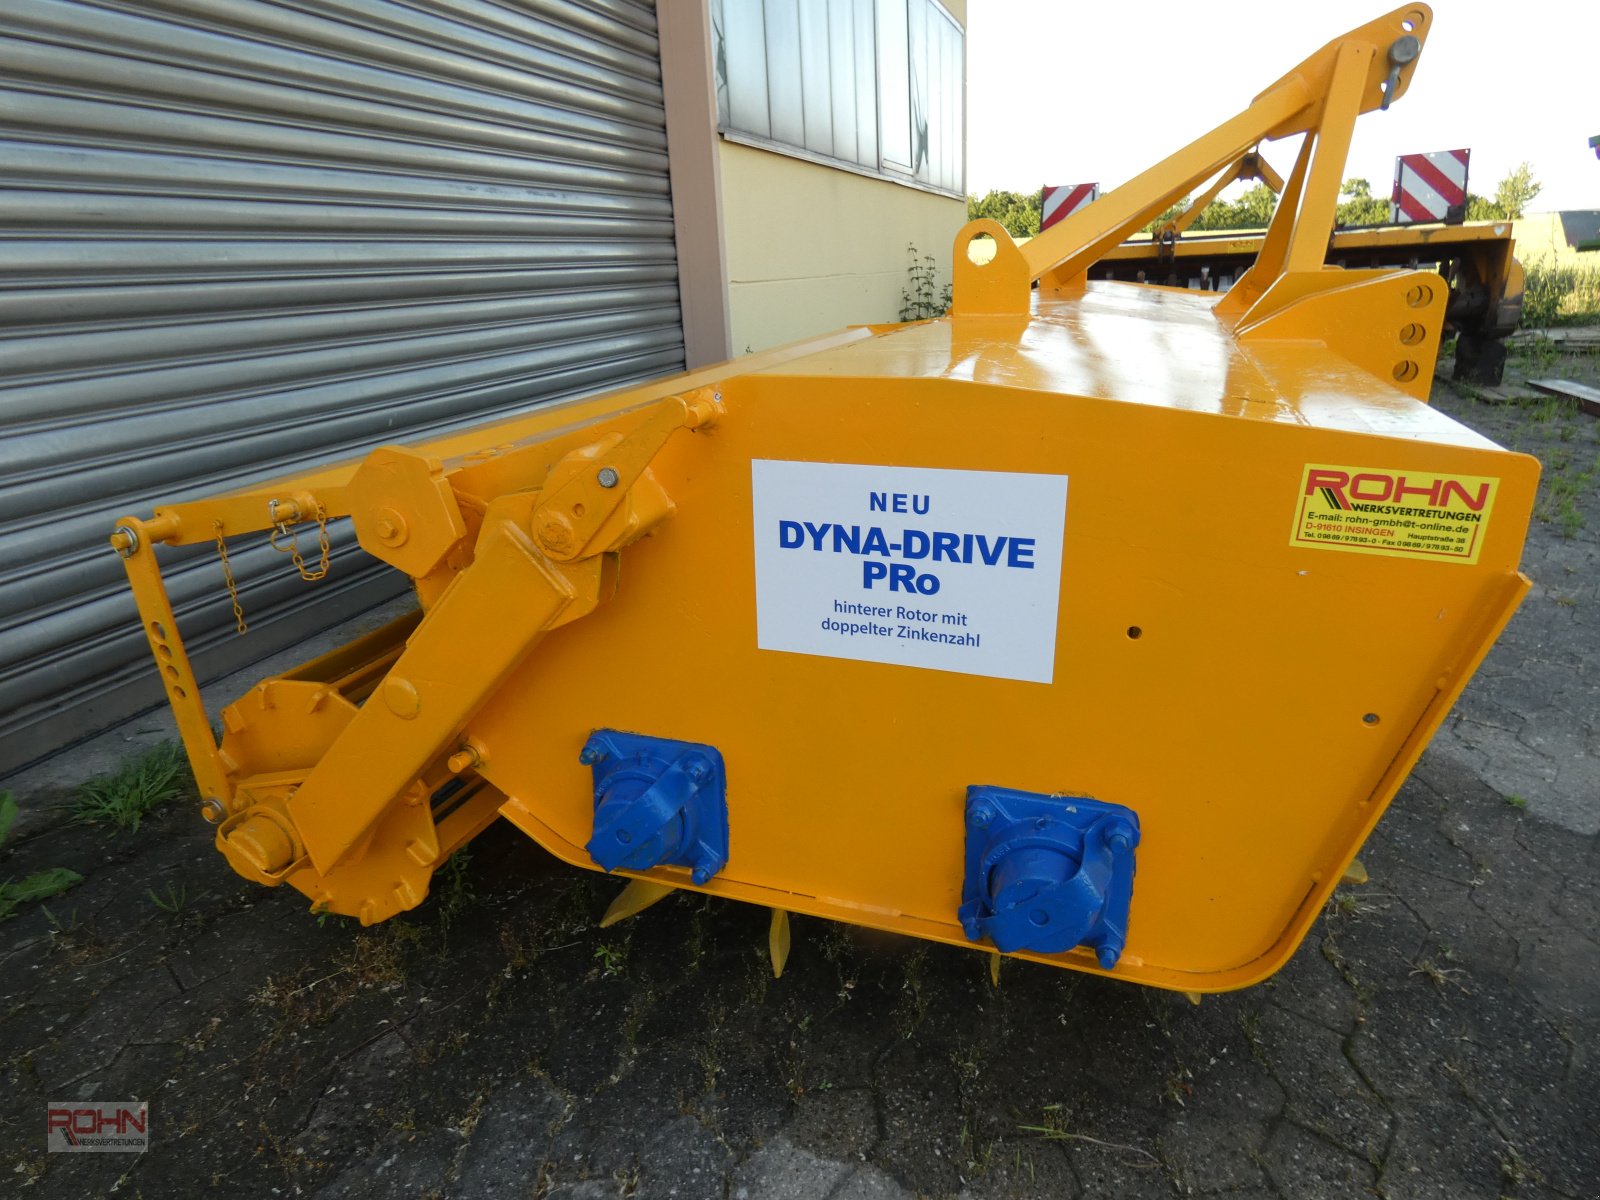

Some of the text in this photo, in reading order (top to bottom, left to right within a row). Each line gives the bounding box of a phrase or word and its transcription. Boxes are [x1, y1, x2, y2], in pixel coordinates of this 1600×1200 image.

[1304, 469, 1491, 512] ROHN
[869, 491, 931, 515] NEU
[1350, 502, 1482, 523] WERKSVERTRETUNGEN
[1305, 521, 1396, 538] D-91610 INSINGEN
[1307, 511, 1470, 534] E-mail: rohn-gmbh@t-online.de
[778, 519, 1036, 570] DYNA-DRIVE
[1381, 538, 1396, 546] Fax
[1407, 532, 1455, 543] Hauptstraße
[862, 560, 941, 596] PRo
[834, 599, 968, 627] hinterer Rotor mit
[820, 617, 981, 647] doppelter Zinkenzahl
